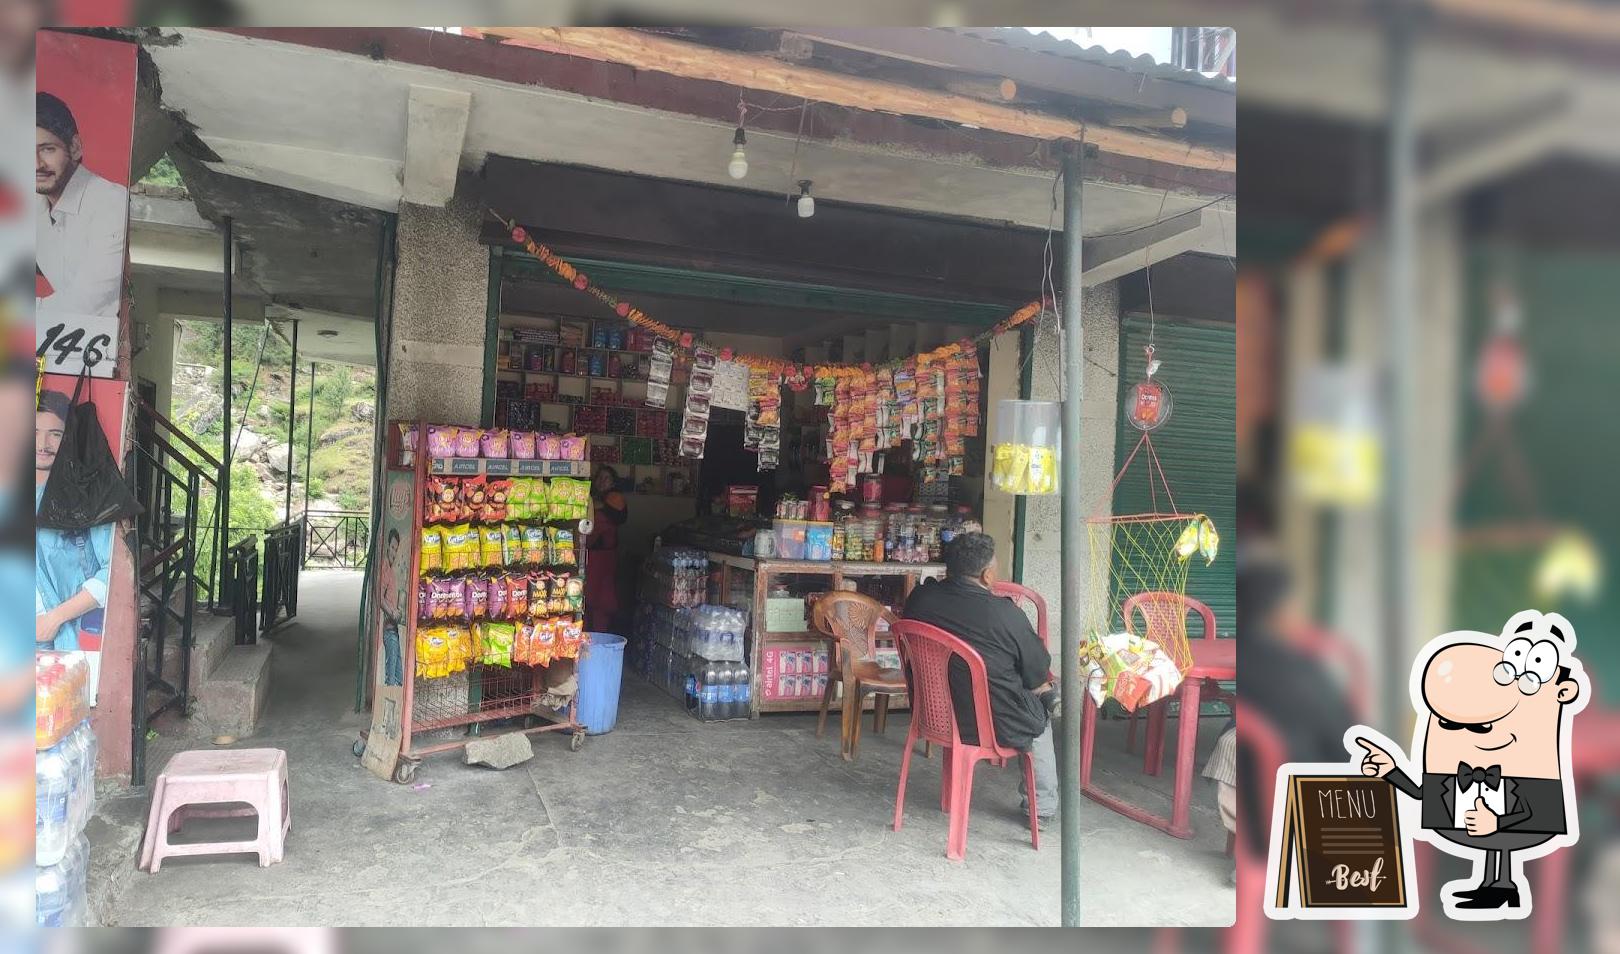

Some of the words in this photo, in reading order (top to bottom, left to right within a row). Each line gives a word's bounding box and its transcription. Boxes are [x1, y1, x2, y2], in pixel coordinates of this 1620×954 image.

[36, 323, 111, 368] 146
[766, 651, 774, 664] 4G
[765, 666, 773, 689] airtel
